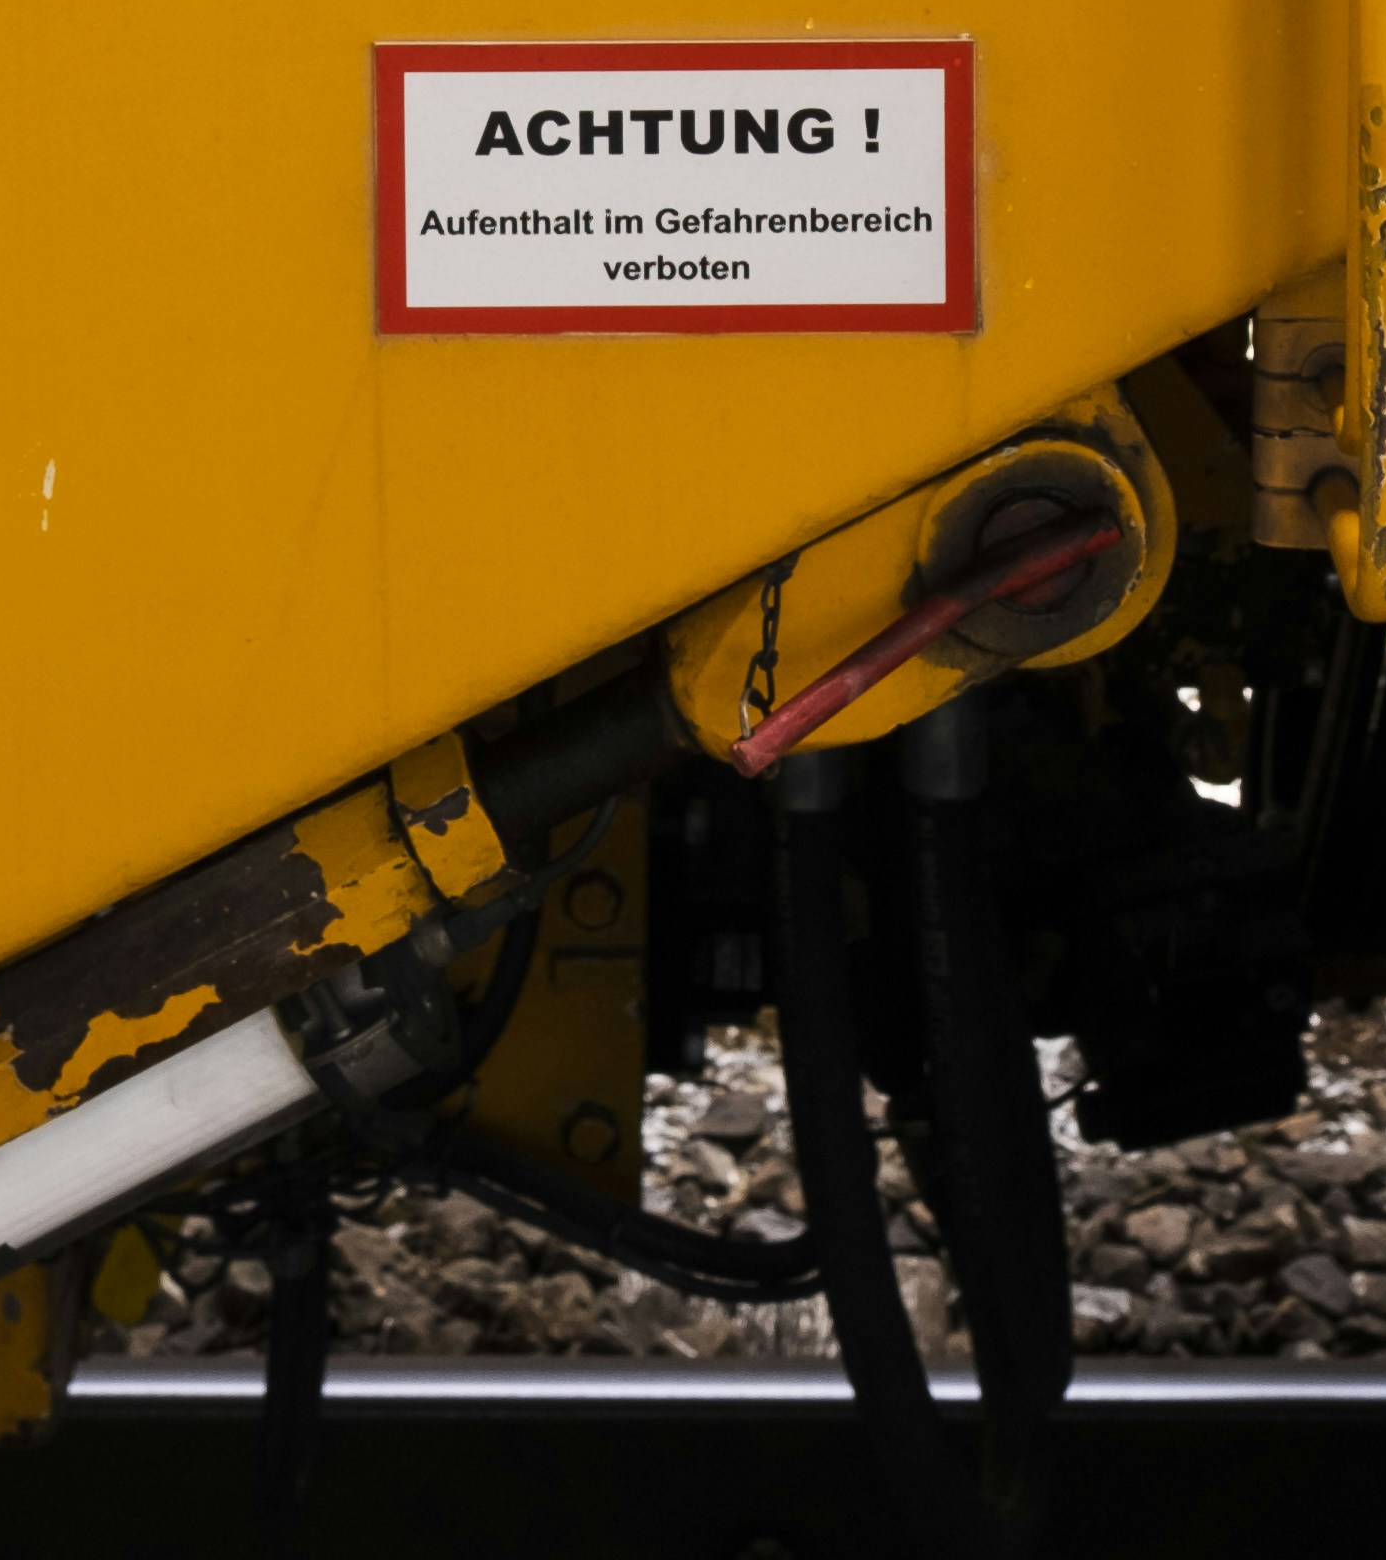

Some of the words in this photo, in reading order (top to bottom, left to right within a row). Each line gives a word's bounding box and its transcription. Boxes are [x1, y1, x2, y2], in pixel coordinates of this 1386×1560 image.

[475, 107, 835, 157] ACHTUNG
[864, 107, 881, 153] !
[420, 208, 594, 236] Aufenthalt
[605, 208, 644, 235] im
[655, 206, 933, 236] Gefahrenbereich
[603, 254, 751, 281] verboten
